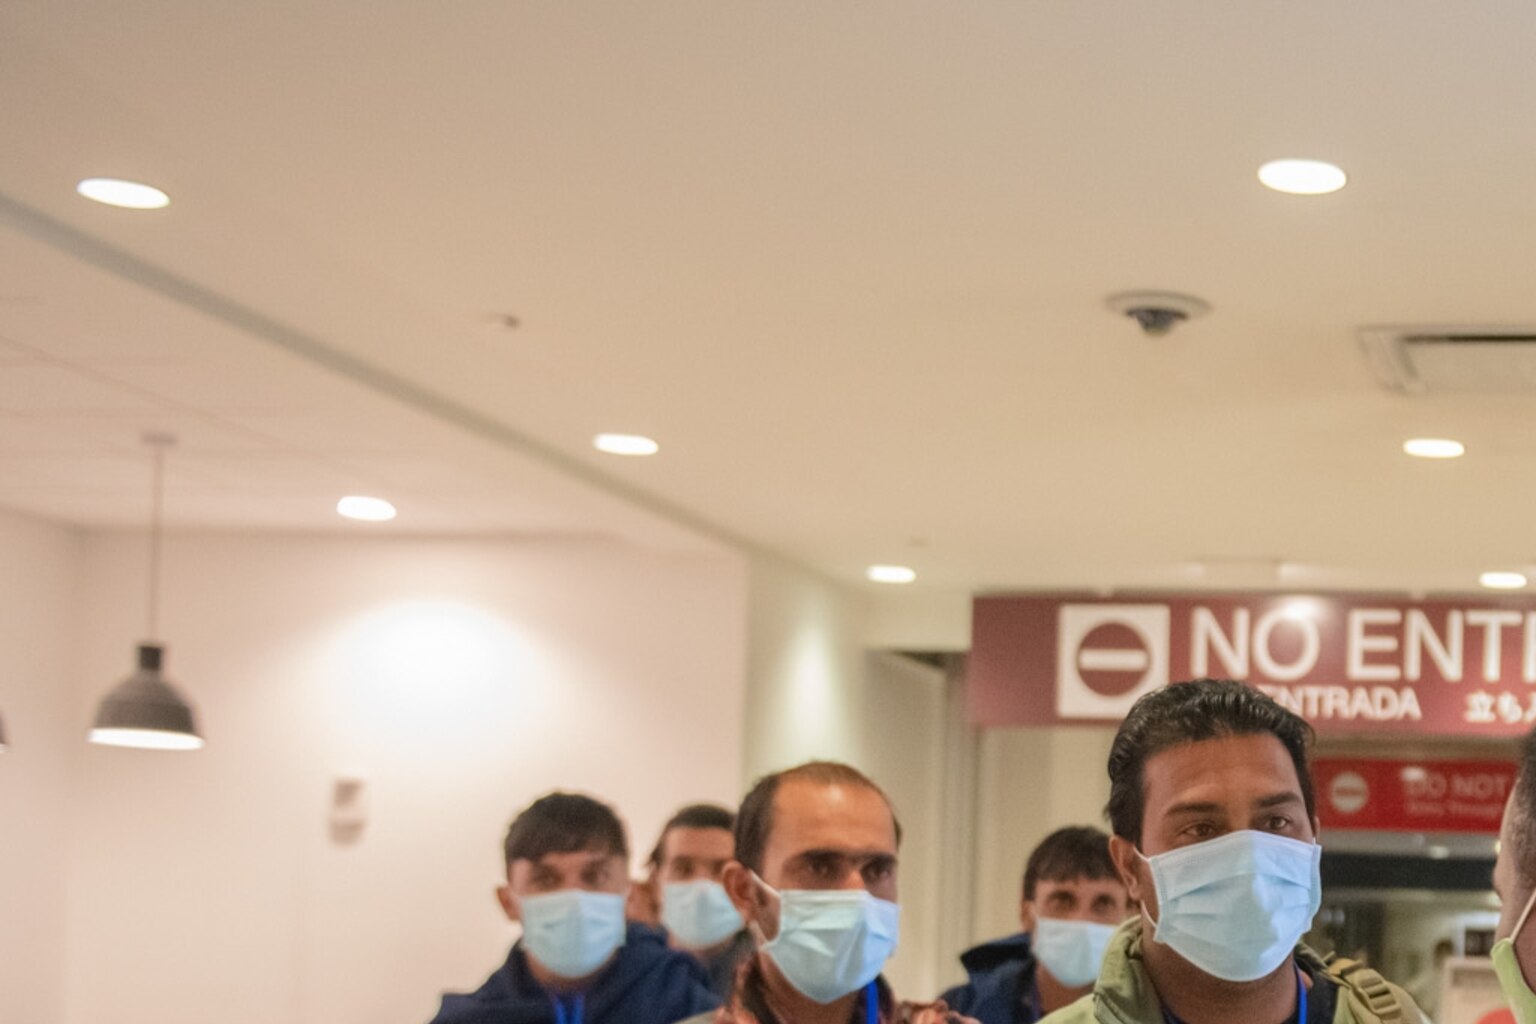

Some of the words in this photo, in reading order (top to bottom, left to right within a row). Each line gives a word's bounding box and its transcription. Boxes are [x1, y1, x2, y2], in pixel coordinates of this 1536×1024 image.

[1191, 606, 1320, 681] NO
[1257, 684, 1422, 721] NTRADA
[1453, 772, 1508, 798] NOT
